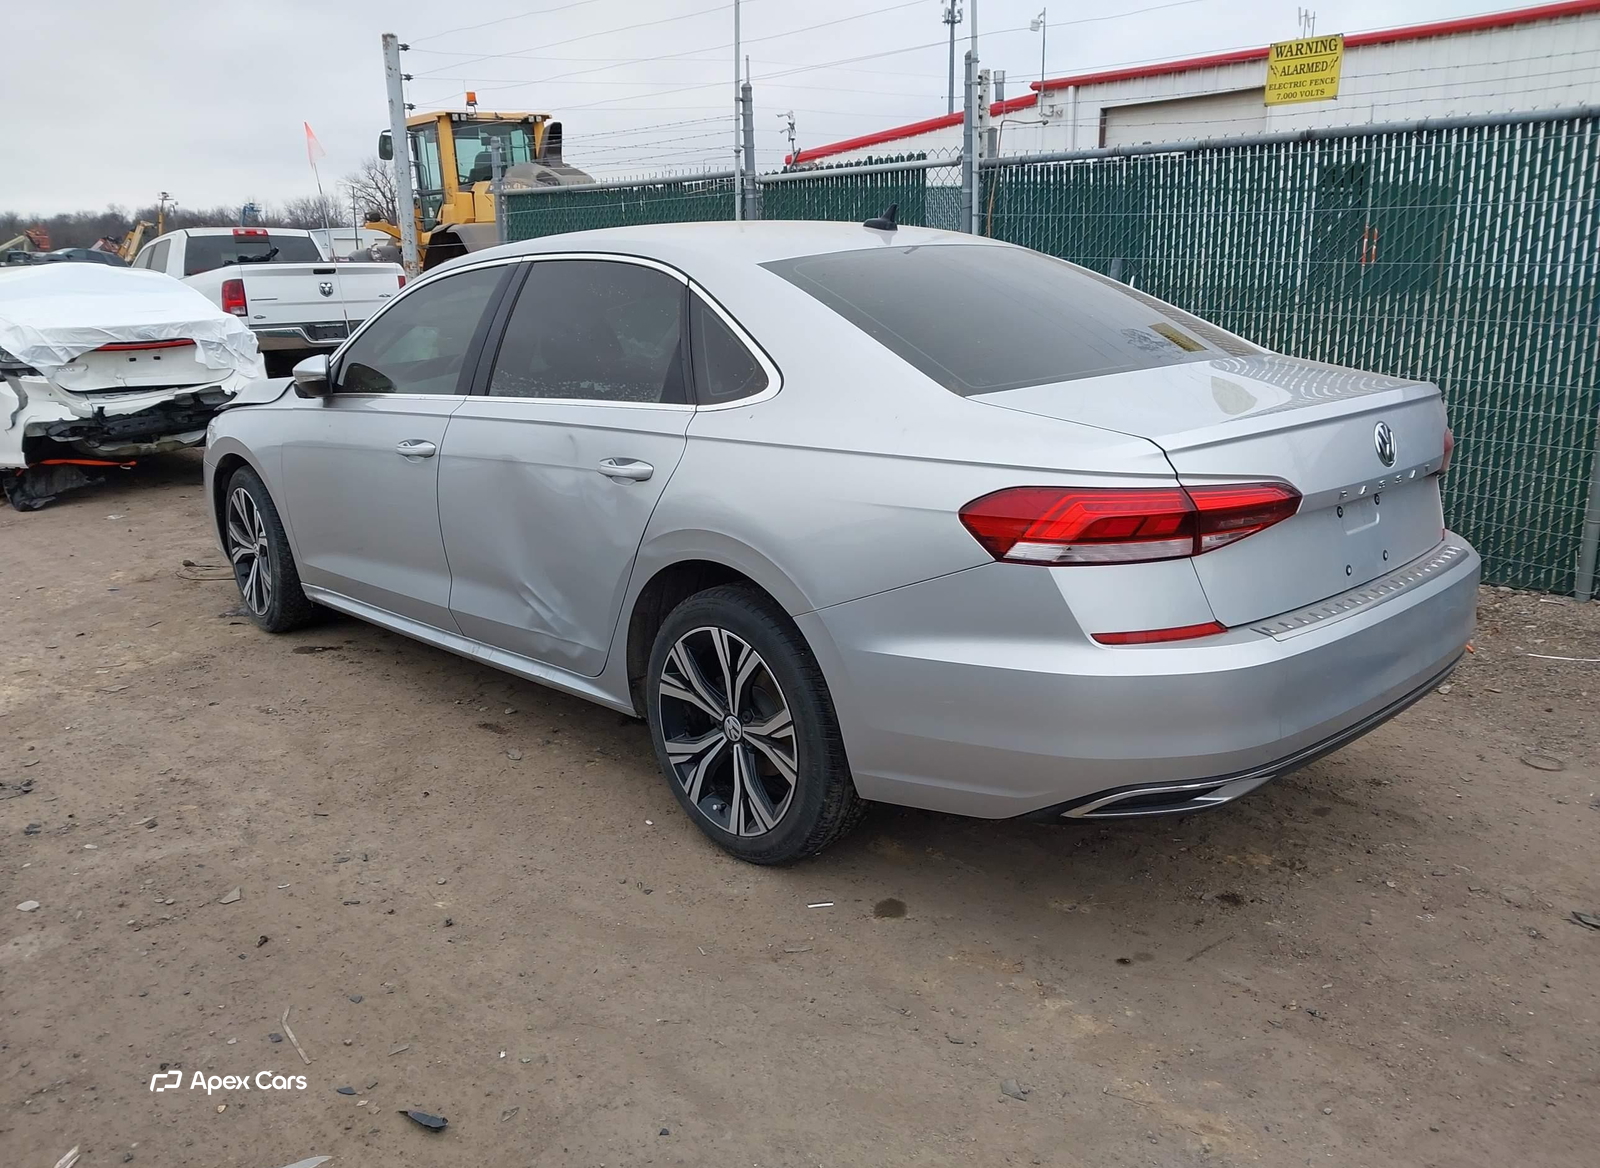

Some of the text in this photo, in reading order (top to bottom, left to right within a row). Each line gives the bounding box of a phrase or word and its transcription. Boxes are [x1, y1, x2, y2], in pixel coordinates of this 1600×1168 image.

[1275, 38, 1338, 59] WARNING
[1280, 60, 1328, 77] ALARMED
[1268, 76, 1336, 91] ELECTRIC FENCE
[1300, 88, 1325, 98] VOLTS
